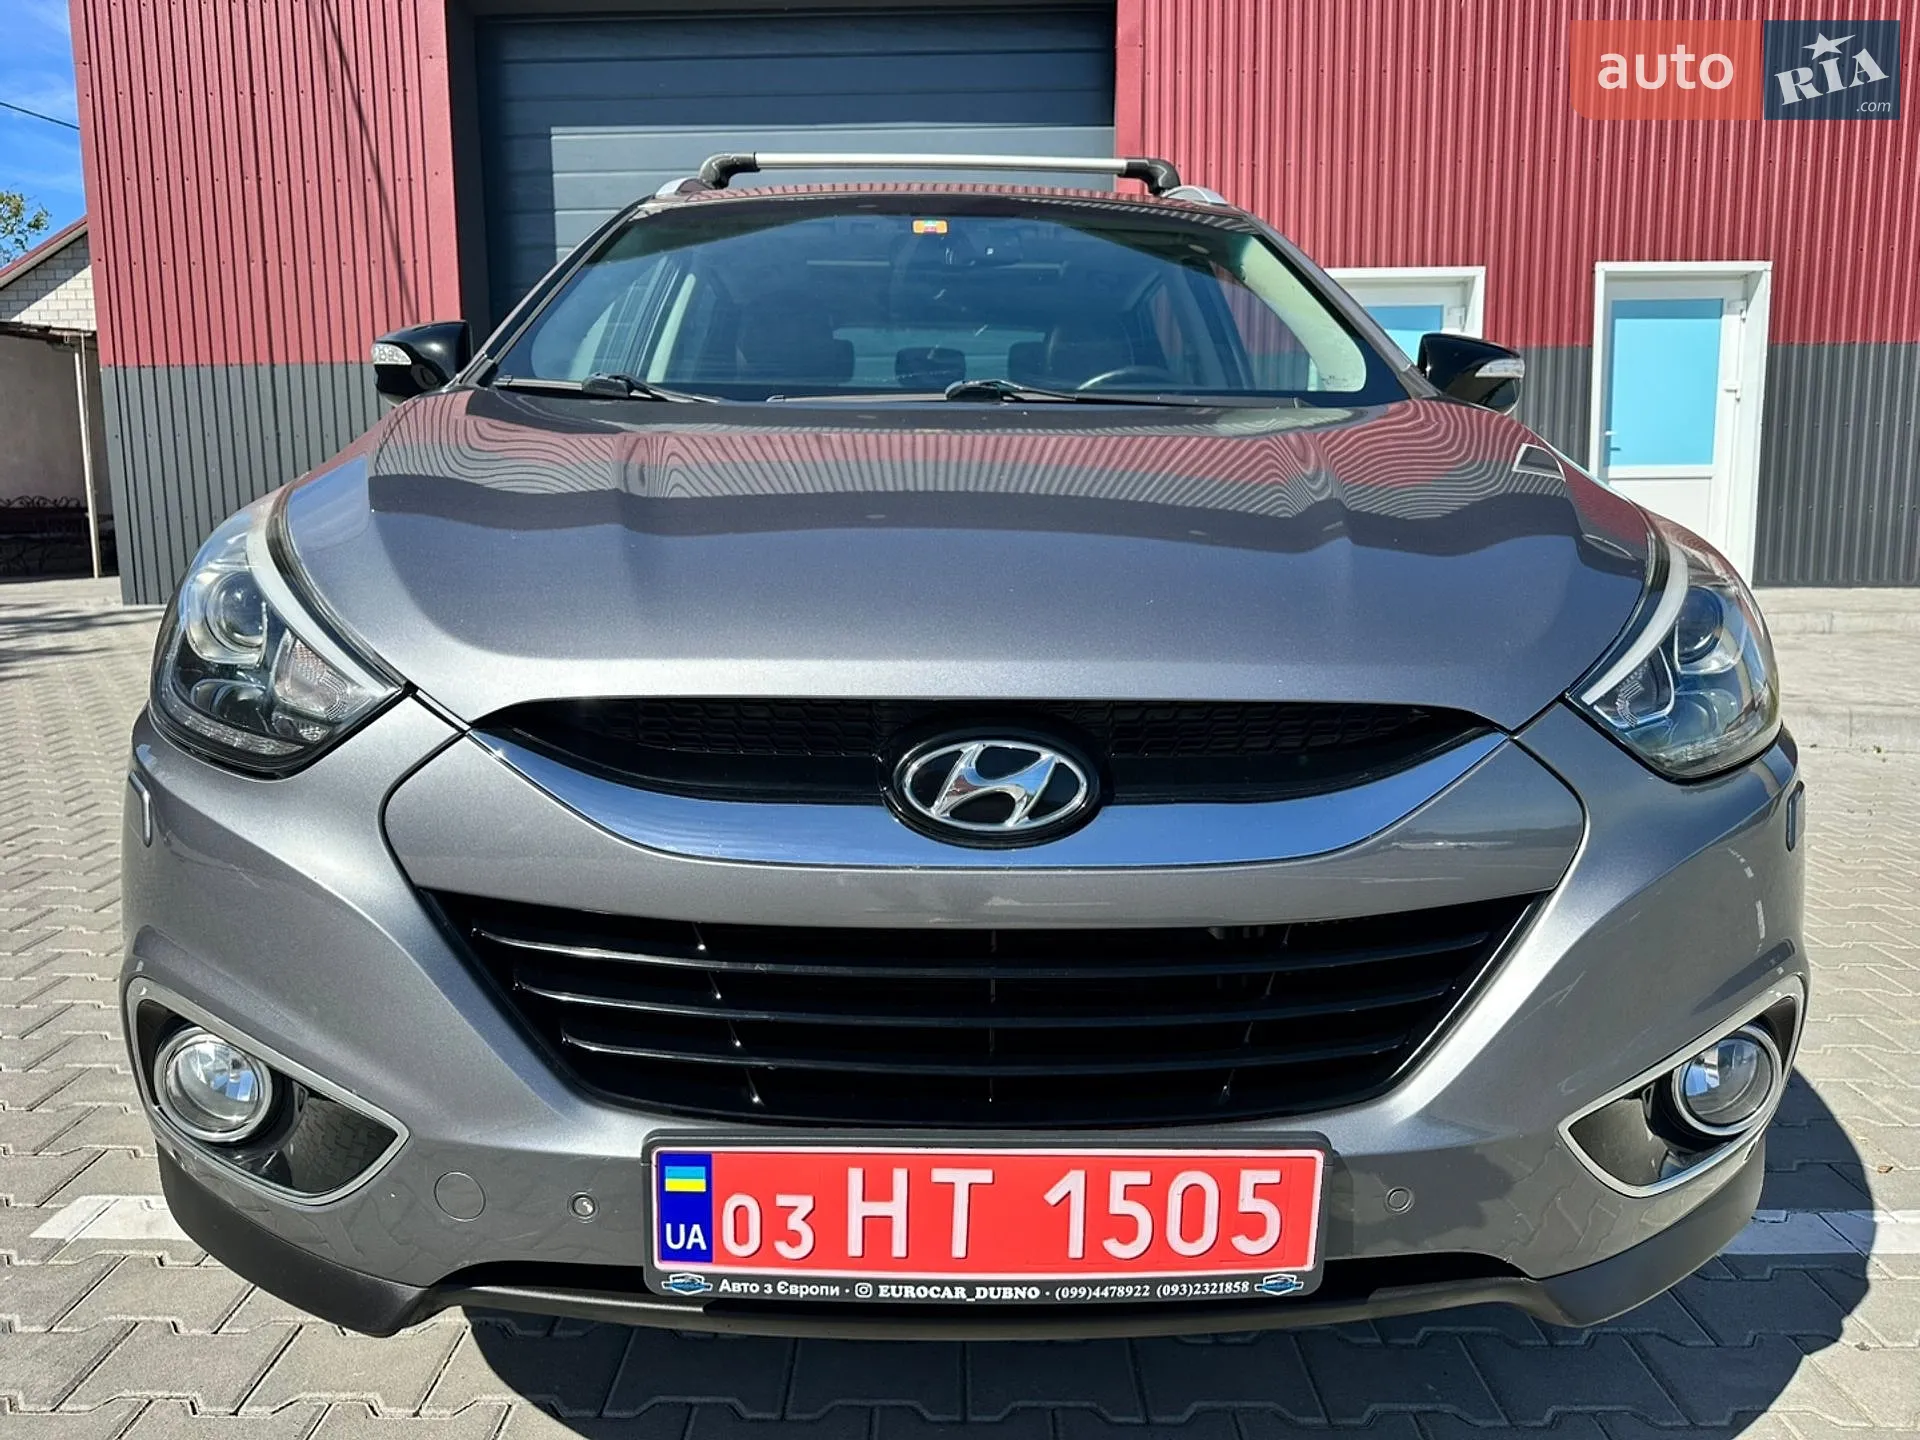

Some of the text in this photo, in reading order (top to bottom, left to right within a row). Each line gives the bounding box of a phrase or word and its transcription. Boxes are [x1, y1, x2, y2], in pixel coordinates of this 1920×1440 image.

[665, 1166, 1283, 1261] UA 03 HT 1505
[718, 1277, 760, 1294] Авто
[763, 1282, 774, 1295] з
[776, 1280, 840, 1299] Європи
[878, 1284, 1041, 1302] EUROCAR_DUBNO
[1055, 1284, 1151, 1301] (099)4478922
[1156, 1280, 1250, 1299] (093)2321858
